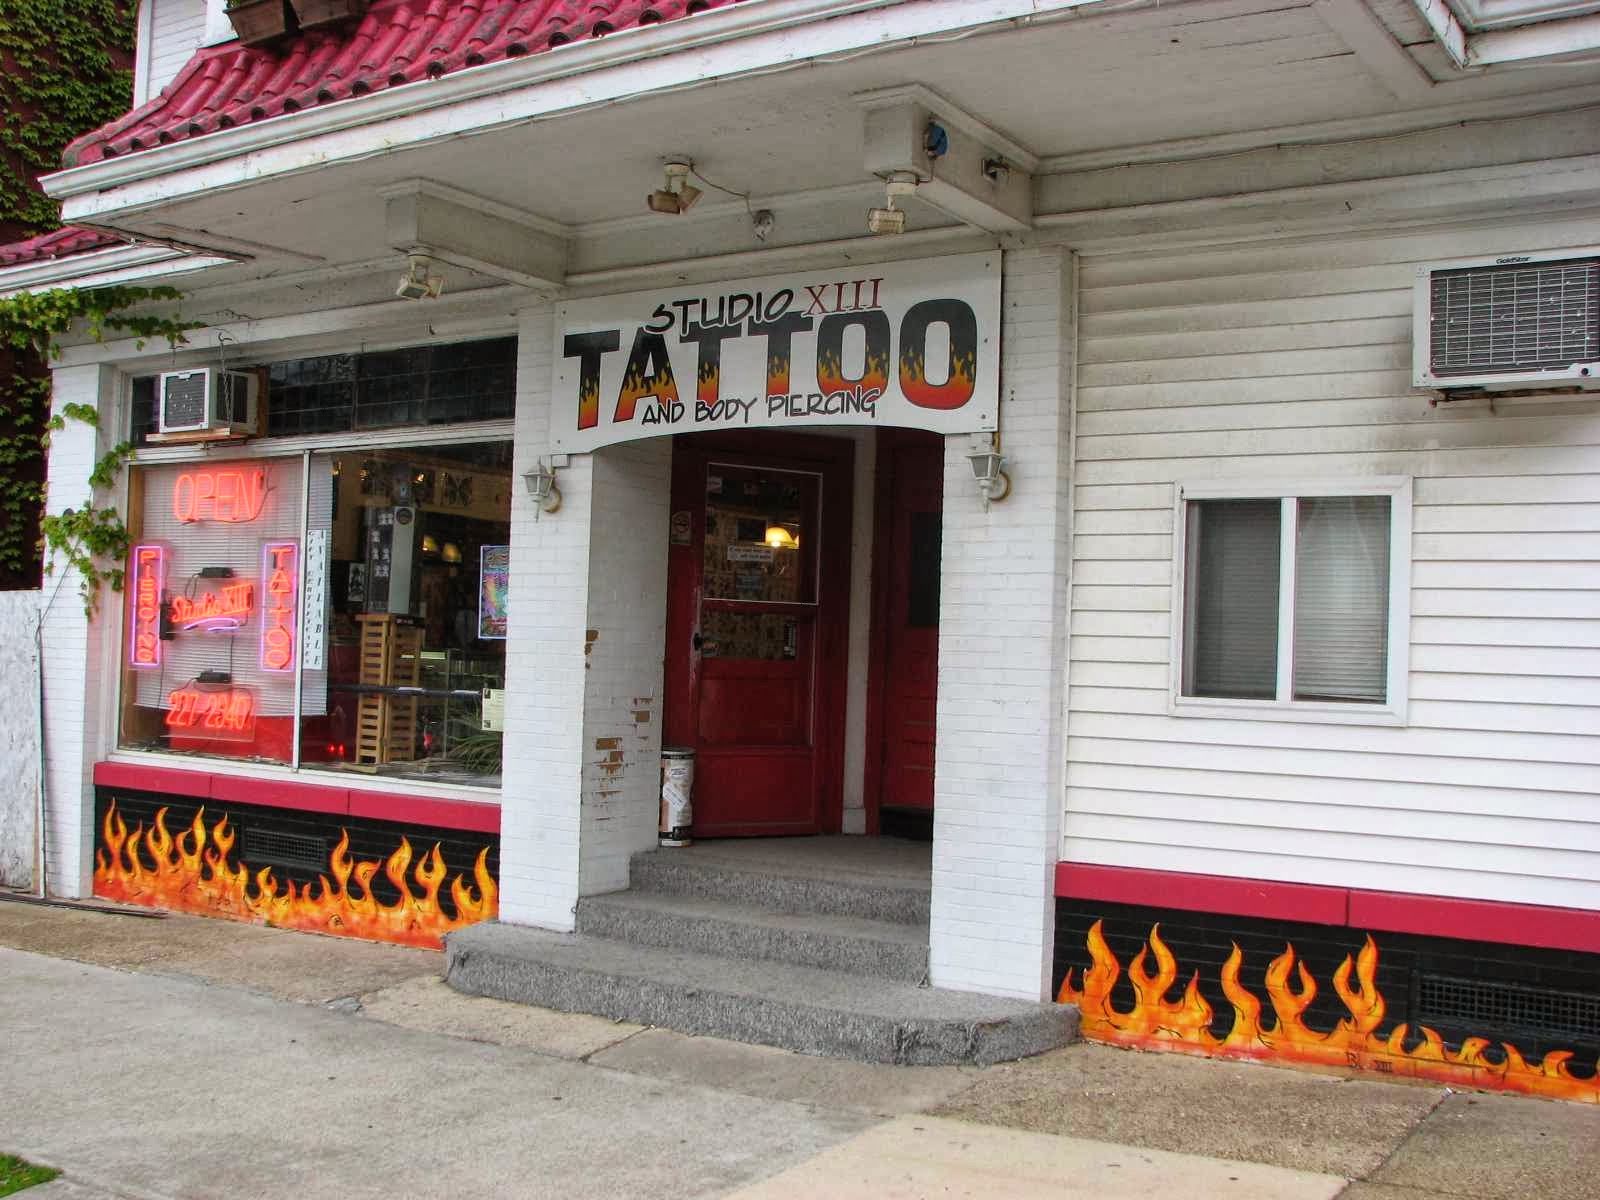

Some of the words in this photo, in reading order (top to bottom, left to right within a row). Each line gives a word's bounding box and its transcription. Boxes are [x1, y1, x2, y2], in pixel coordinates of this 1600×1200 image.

[643, 288, 794, 337] STUDIO
[804, 278, 884, 315] XIII
[563, 297, 978, 431] TATTOO
[641, 399, 686, 425] AND
[694, 397, 758, 424] BODY
[766, 386, 881, 418] PIERCING
[174, 471, 259, 521] OPEN
[137, 550, 157, 662] PIERCING
[266, 547, 293, 668] TATTOO
